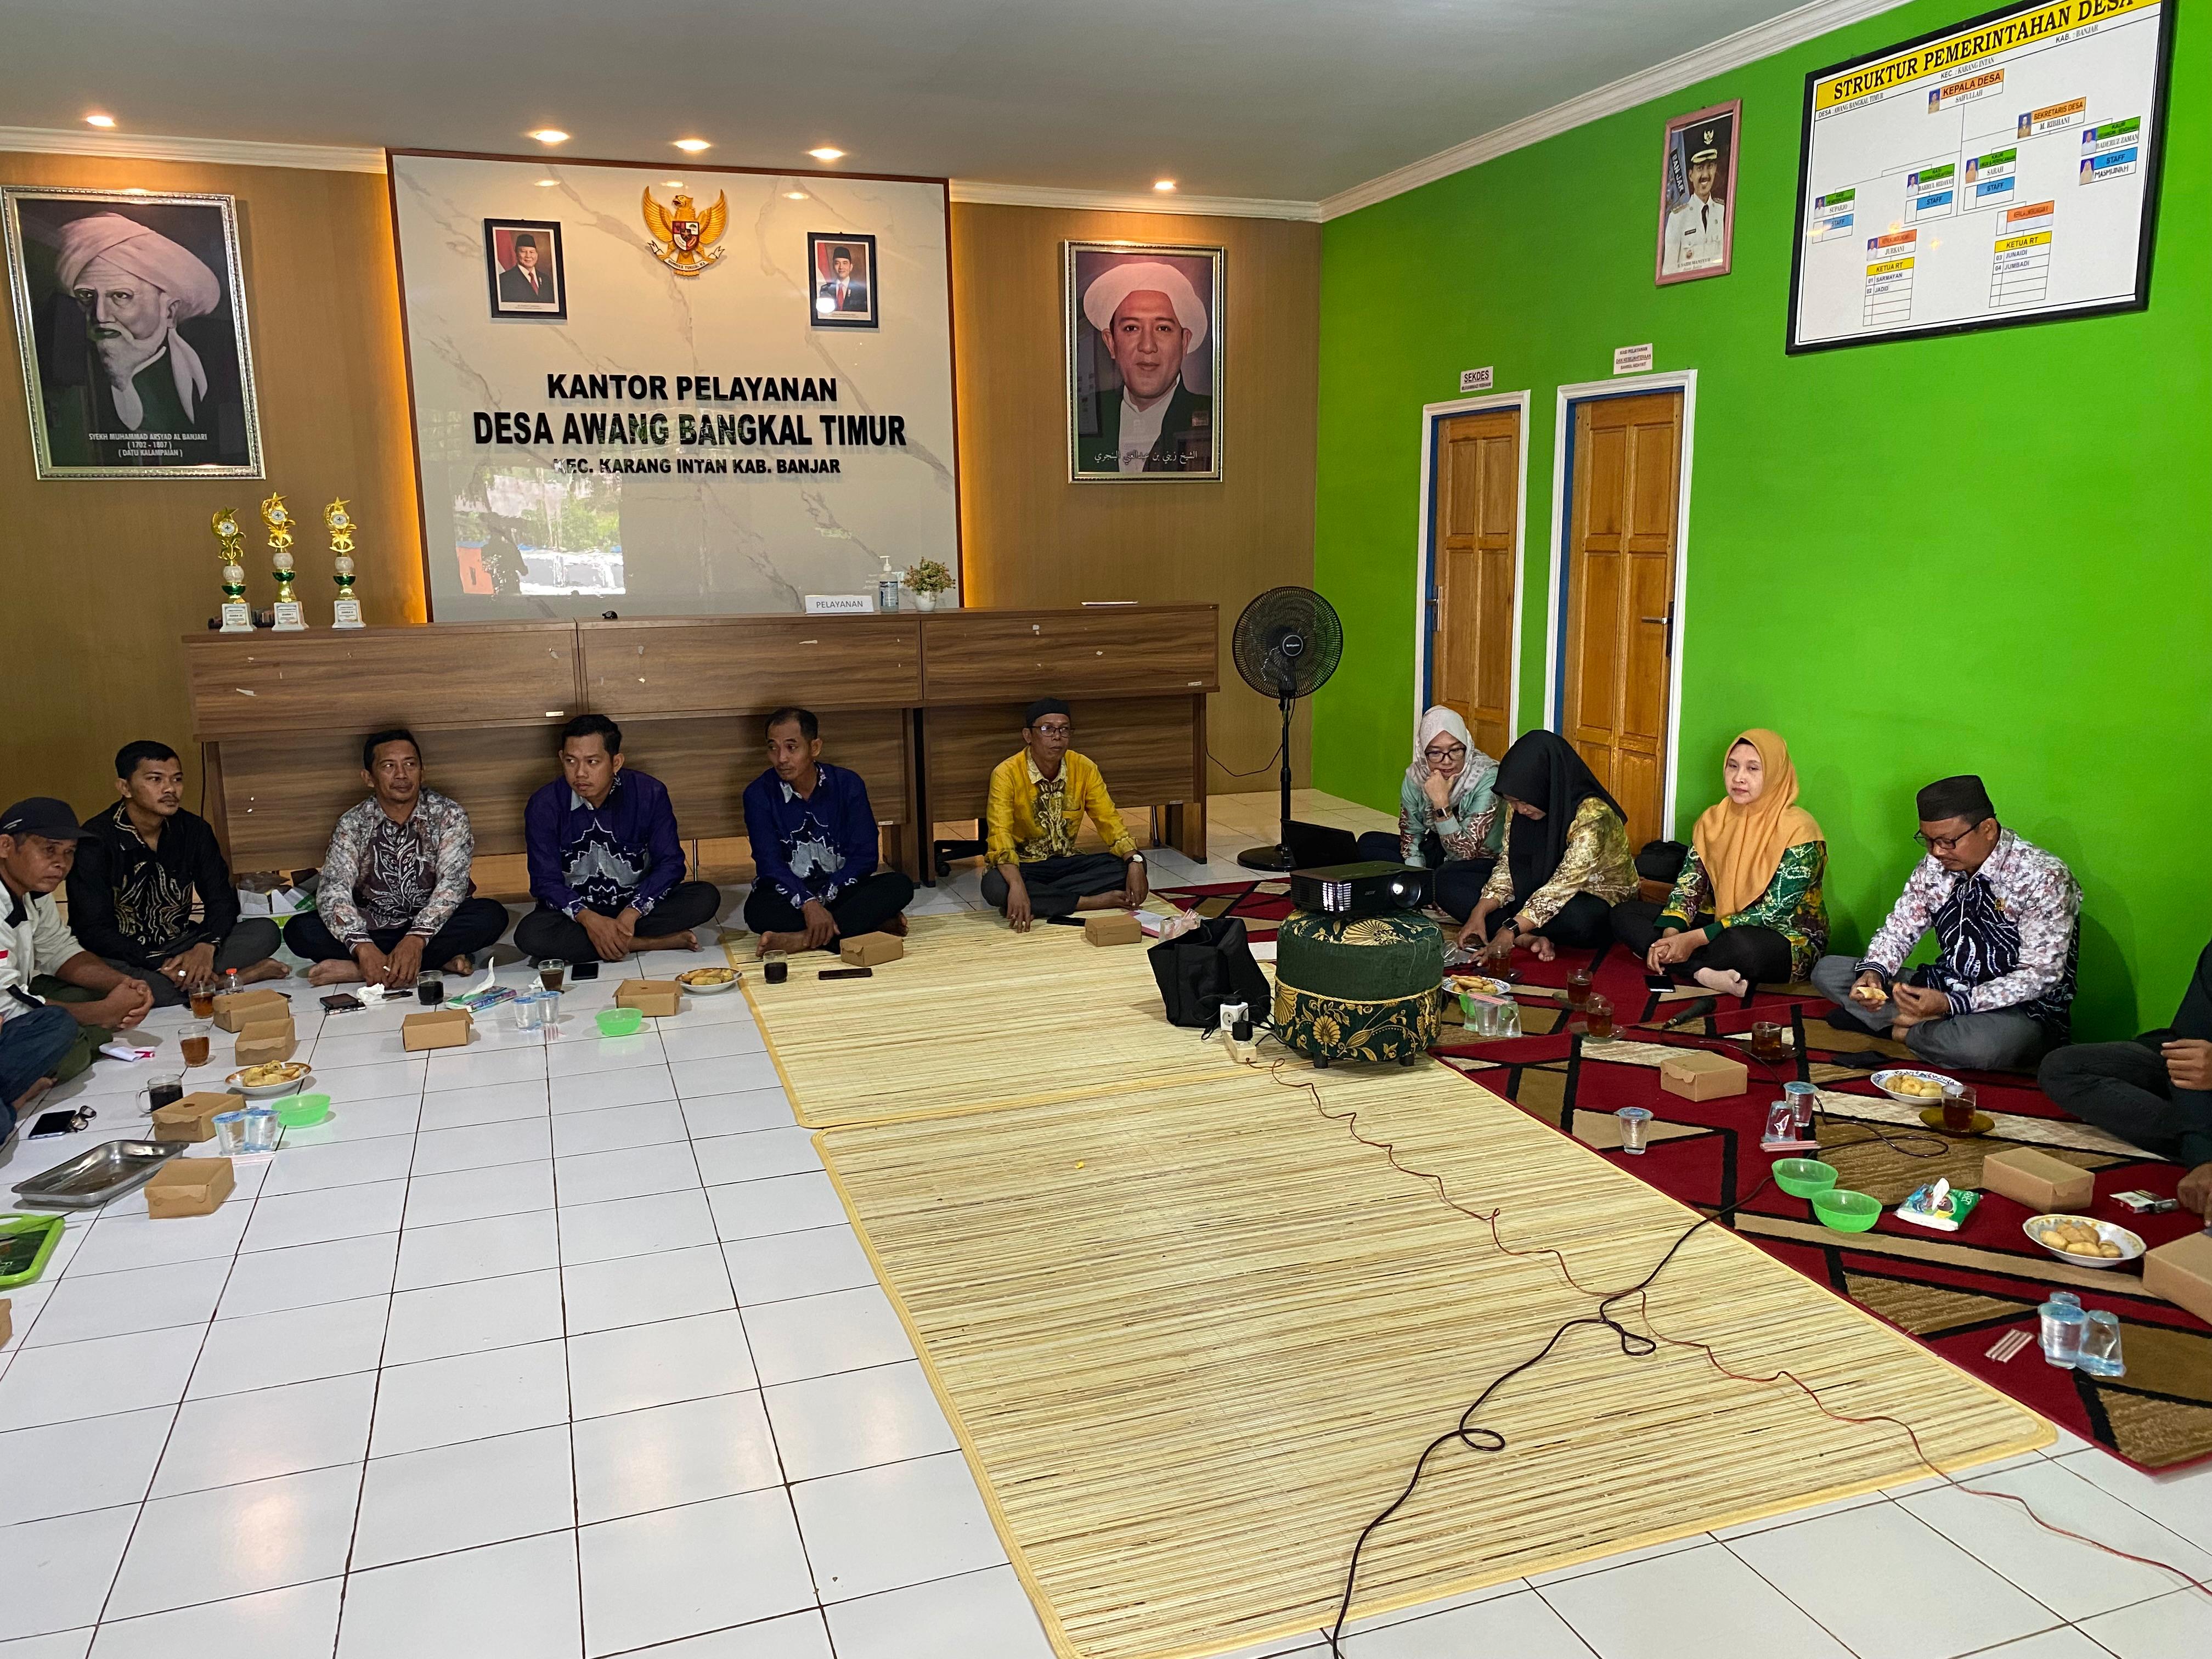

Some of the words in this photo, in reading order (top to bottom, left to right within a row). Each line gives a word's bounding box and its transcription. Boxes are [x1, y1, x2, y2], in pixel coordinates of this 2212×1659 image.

[2076, 24, 2098, 37] BANJAR
[1834, 57, 1918, 100] STRUKTUR
[1923, 5, 2072, 71] PEMERINTAHAN
[1957, 61, 1978, 75] KARANG
[1979, 57, 1994, 67] INTAN
[1943, 80, 1976, 97] KEPALA
[1977, 72, 2001, 87] DESA
[1955, 89, 1983, 103] SAIFULLAH
[1818, 109, 1832, 119] DESA
[1849, 97, 1869, 109] BANGKAL
[2033, 105, 2067, 120] SEKRETARIS
[2068, 101, 2083, 111] DESA
[2106, 153, 2125, 164] STAFF
[1672, 154, 1684, 192] BANJAR
[1987, 182, 2005, 191] STAFF
[1926, 196, 1943, 205] STAFF
[2006, 239, 2028, 249] KETUA
[2029, 236, 2039, 245] RT
[2005, 249, 2028, 259] JUNAIDI
[1876, 263, 1894, 273] KETUA
[2004, 260, 2030, 270] JUMBADI
[1876, 272, 1903, 283] SARMAYAN
[1464, 370, 1489, 383] SEKDES
[548, 374, 669, 400] KANTOR
[676, 376, 837, 402] PELAYANAN
[473, 411, 554, 444] DESA
[562, 413, 669, 445] AWANG
[679, 414, 812, 445] BANGKAL
[819, 415, 906, 446] TIMUR
[1179, 450, 1198, 465] الشيخ
[554, 458, 594, 473] KEC.
[599, 458, 671, 473] KARANG
[676, 459, 727, 473] INTAN
[733, 459, 771, 473] KAB.
[777, 459, 840, 473] BANJAR
[816, 600, 864, 608] PELAYANAN
